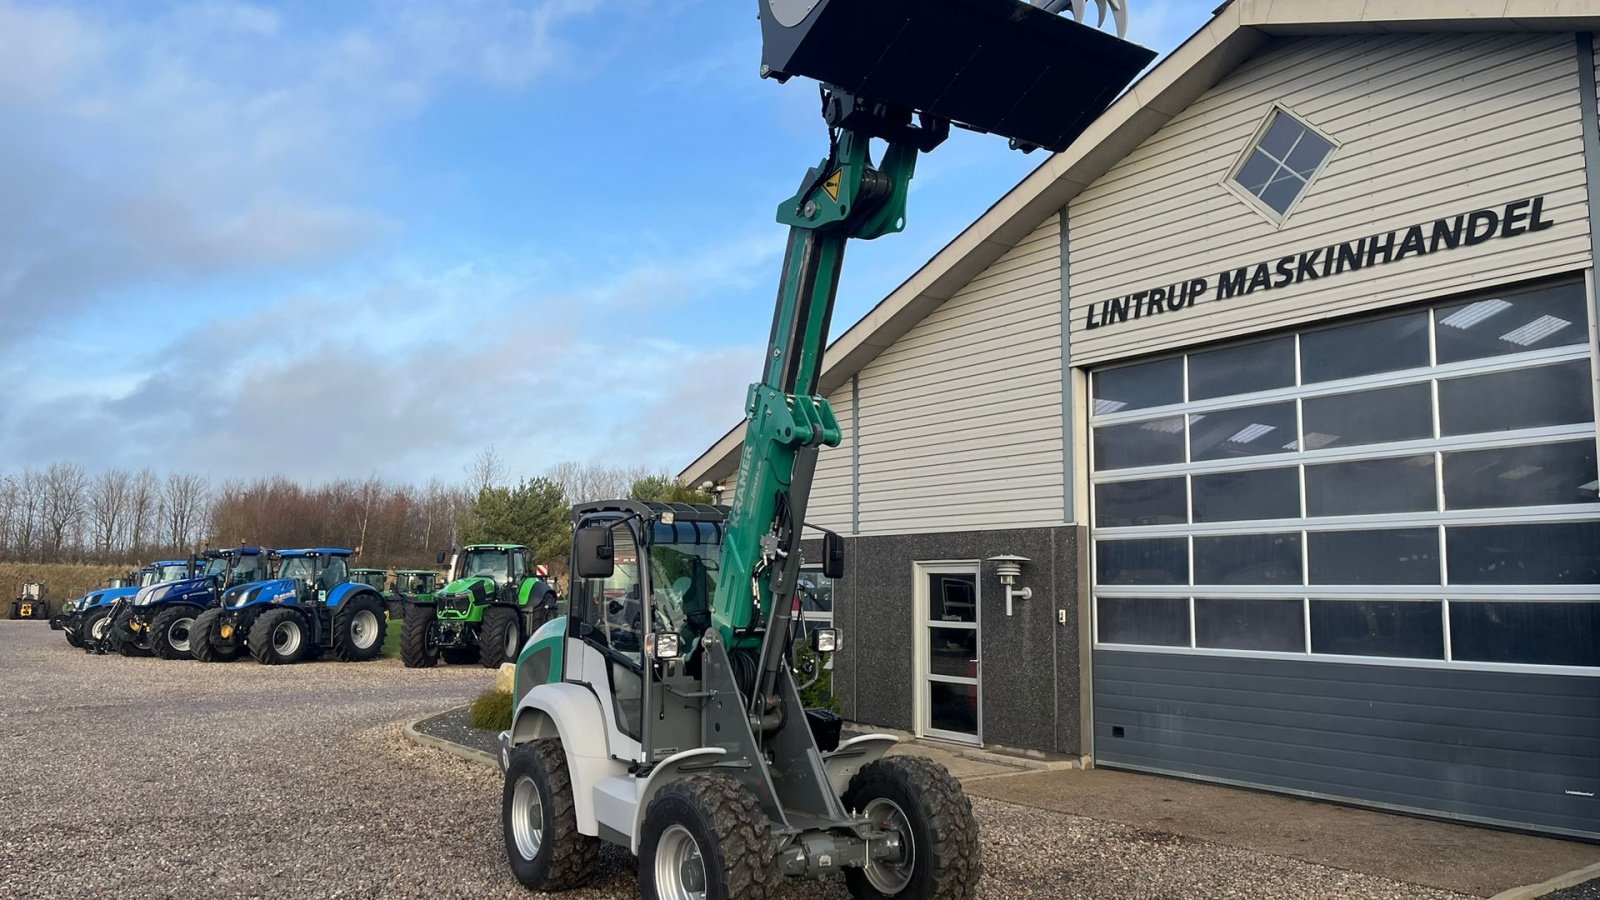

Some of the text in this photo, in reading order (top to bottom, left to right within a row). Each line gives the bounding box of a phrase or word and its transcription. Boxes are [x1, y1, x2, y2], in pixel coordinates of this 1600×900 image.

[1086, 196, 1553, 330] LINTRUP MASKINHANDEL
[731, 445, 753, 529] KRAMER
